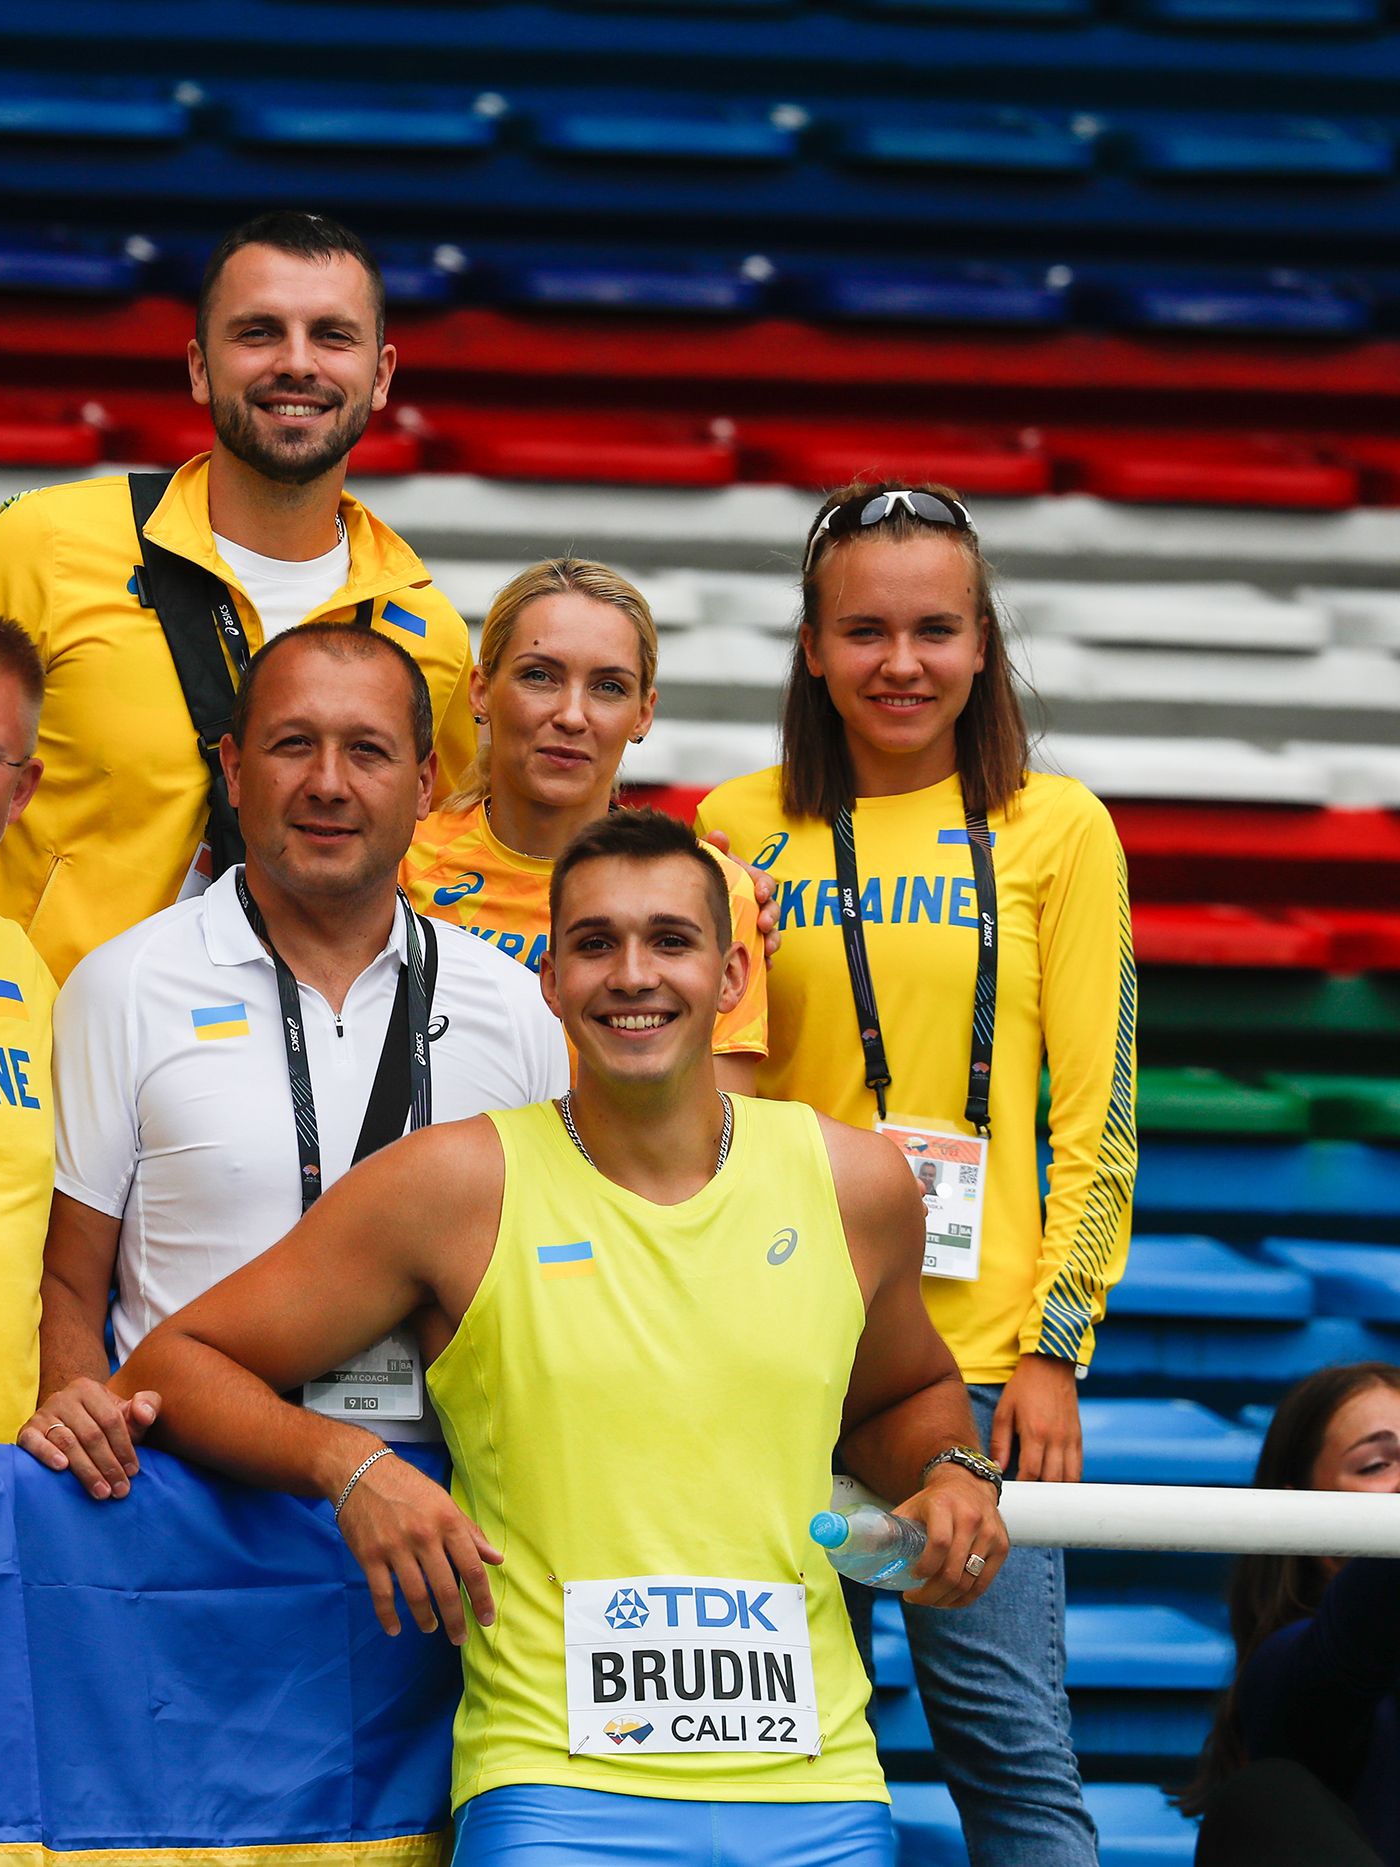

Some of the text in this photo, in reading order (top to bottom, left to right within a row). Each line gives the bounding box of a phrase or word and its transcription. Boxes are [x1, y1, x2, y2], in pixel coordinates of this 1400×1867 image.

[219, 604, 235, 628] asics
[772, 876, 980, 931] KRAINE
[843, 887, 852, 908] asics
[983, 924, 993, 948] asics
[291, 1028, 301, 1053] asics
[414, 1032, 425, 1056] asics
[335, 1374, 389, 1382] TEAM COACH
[349, 1398, 376, 1409] 9 10
[647, 1586, 779, 1632] TDK
[591, 1648, 797, 1703] BRUDIN
[671, 1714, 798, 1743] CALI 22
